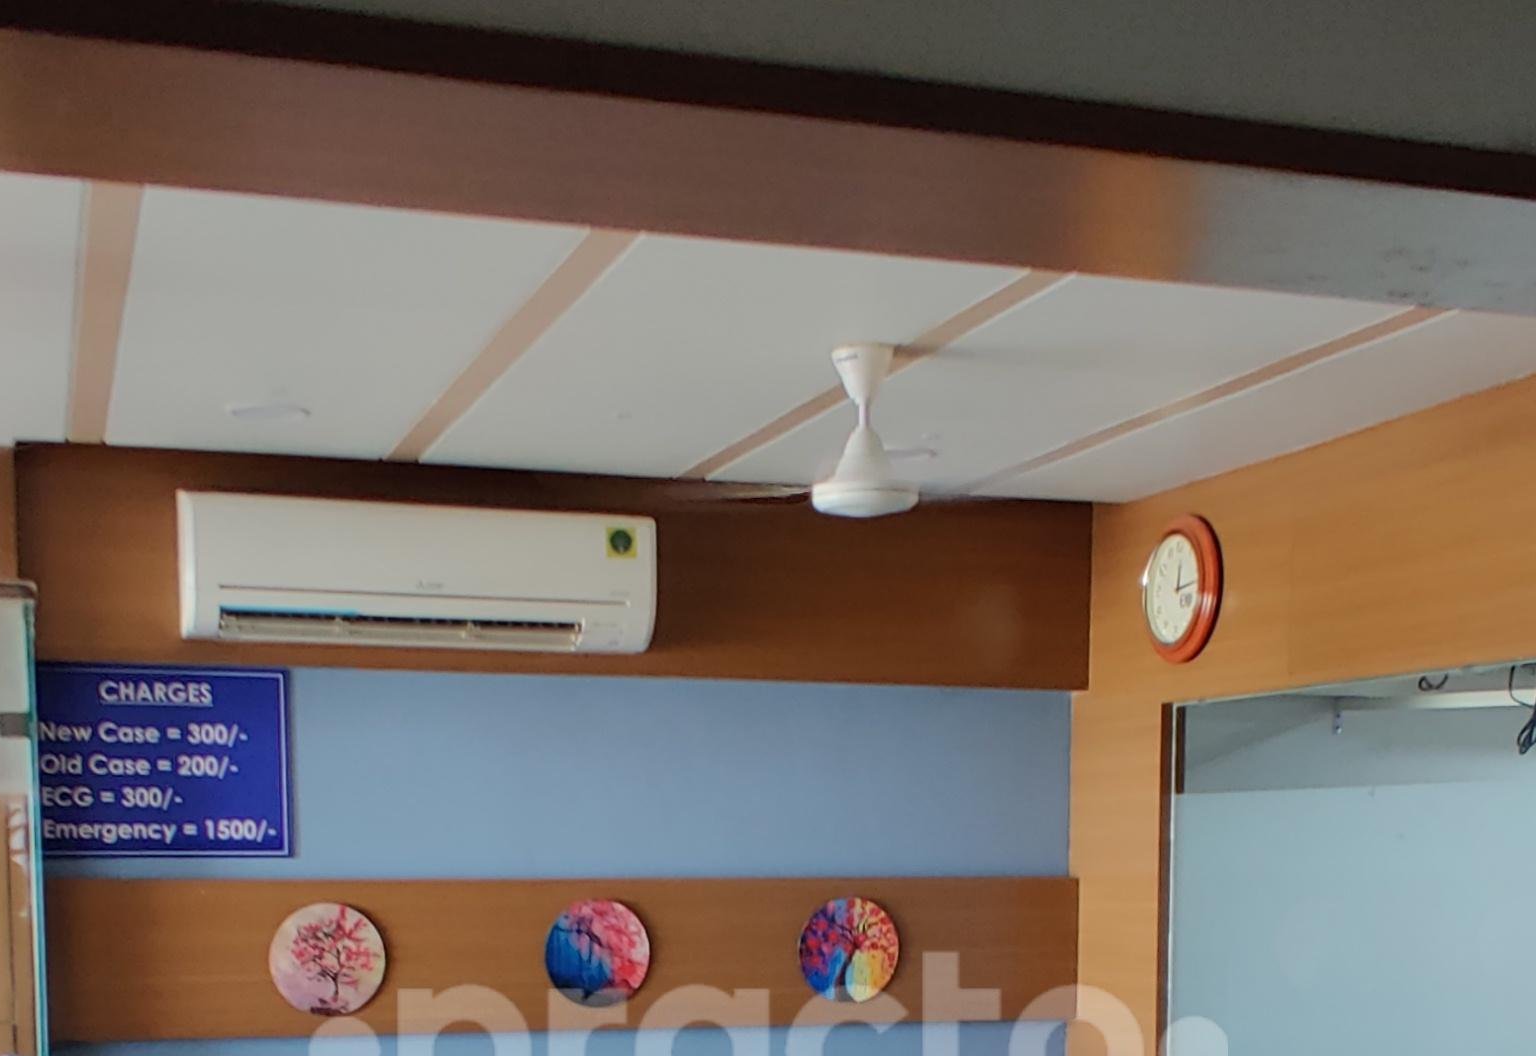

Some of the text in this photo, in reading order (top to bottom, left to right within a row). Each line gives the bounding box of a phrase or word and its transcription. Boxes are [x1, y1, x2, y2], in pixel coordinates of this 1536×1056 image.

[98, 680, 214, 705] CHARGES
[39, 722, 93, 742] New
[98, 721, 161, 744] Case
[187, 722, 249, 748] 300/-
[40, 754, 83, 775] Old
[88, 754, 152, 777] Case
[177, 754, 239, 780] 200/-
[41, 786, 95, 807] ECG
[121, 786, 183, 811] 300/-
[42, 819, 177, 844] Emergency
[205, 818, 278, 843] 1500/-
